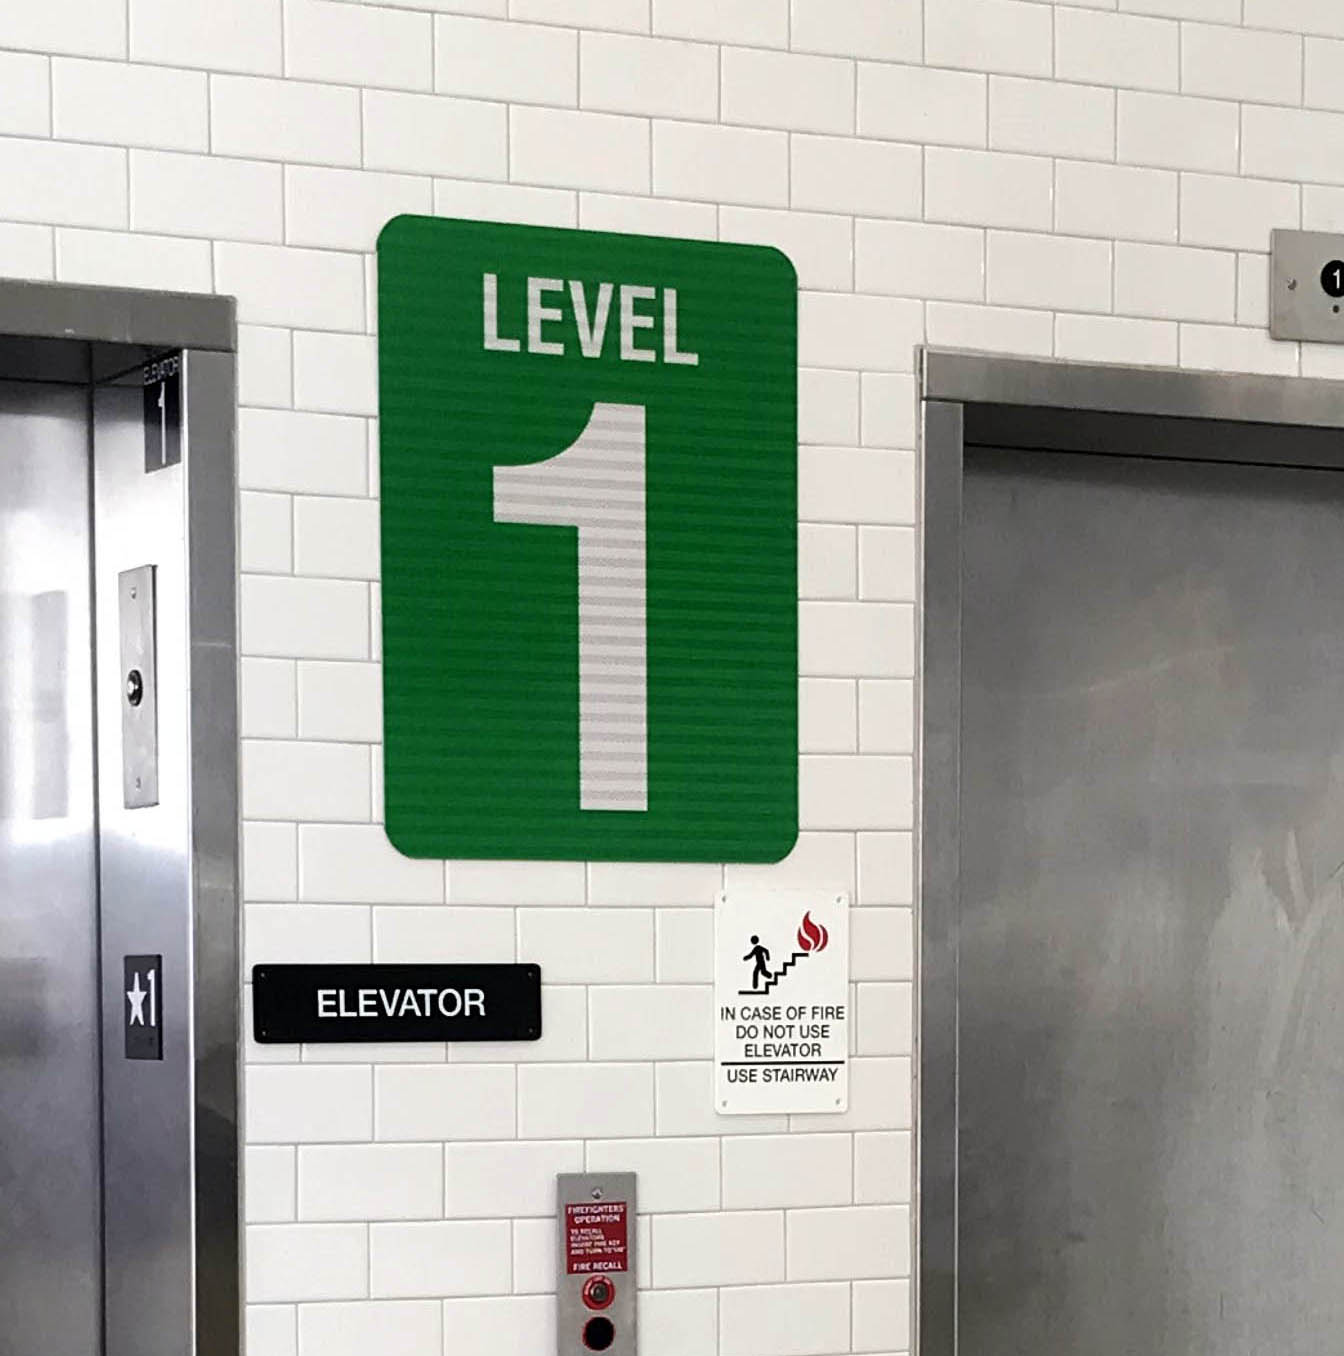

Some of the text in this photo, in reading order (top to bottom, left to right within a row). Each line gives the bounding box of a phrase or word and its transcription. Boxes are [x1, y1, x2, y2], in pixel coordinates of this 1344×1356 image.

[1332, 269, 1341, 289] 1
[483, 273, 699, 365] LEVEL
[158, 382, 167, 465] 1
[492, 401, 648, 811] 1
[147, 969, 156, 1027] 1
[316, 988, 486, 1018] ELEVATOR
[720, 1006, 845, 1021] IN CASE OF FIRE
[736, 1024, 830, 1039] DO NOT USE
[744, 1043, 822, 1057] ELEVATOR
[727, 1068, 838, 1083] USE STAIRWAY
[574, 1215, 620, 1223] OPERATION
[573, 1261, 622, 1271] FIRE RECALL
